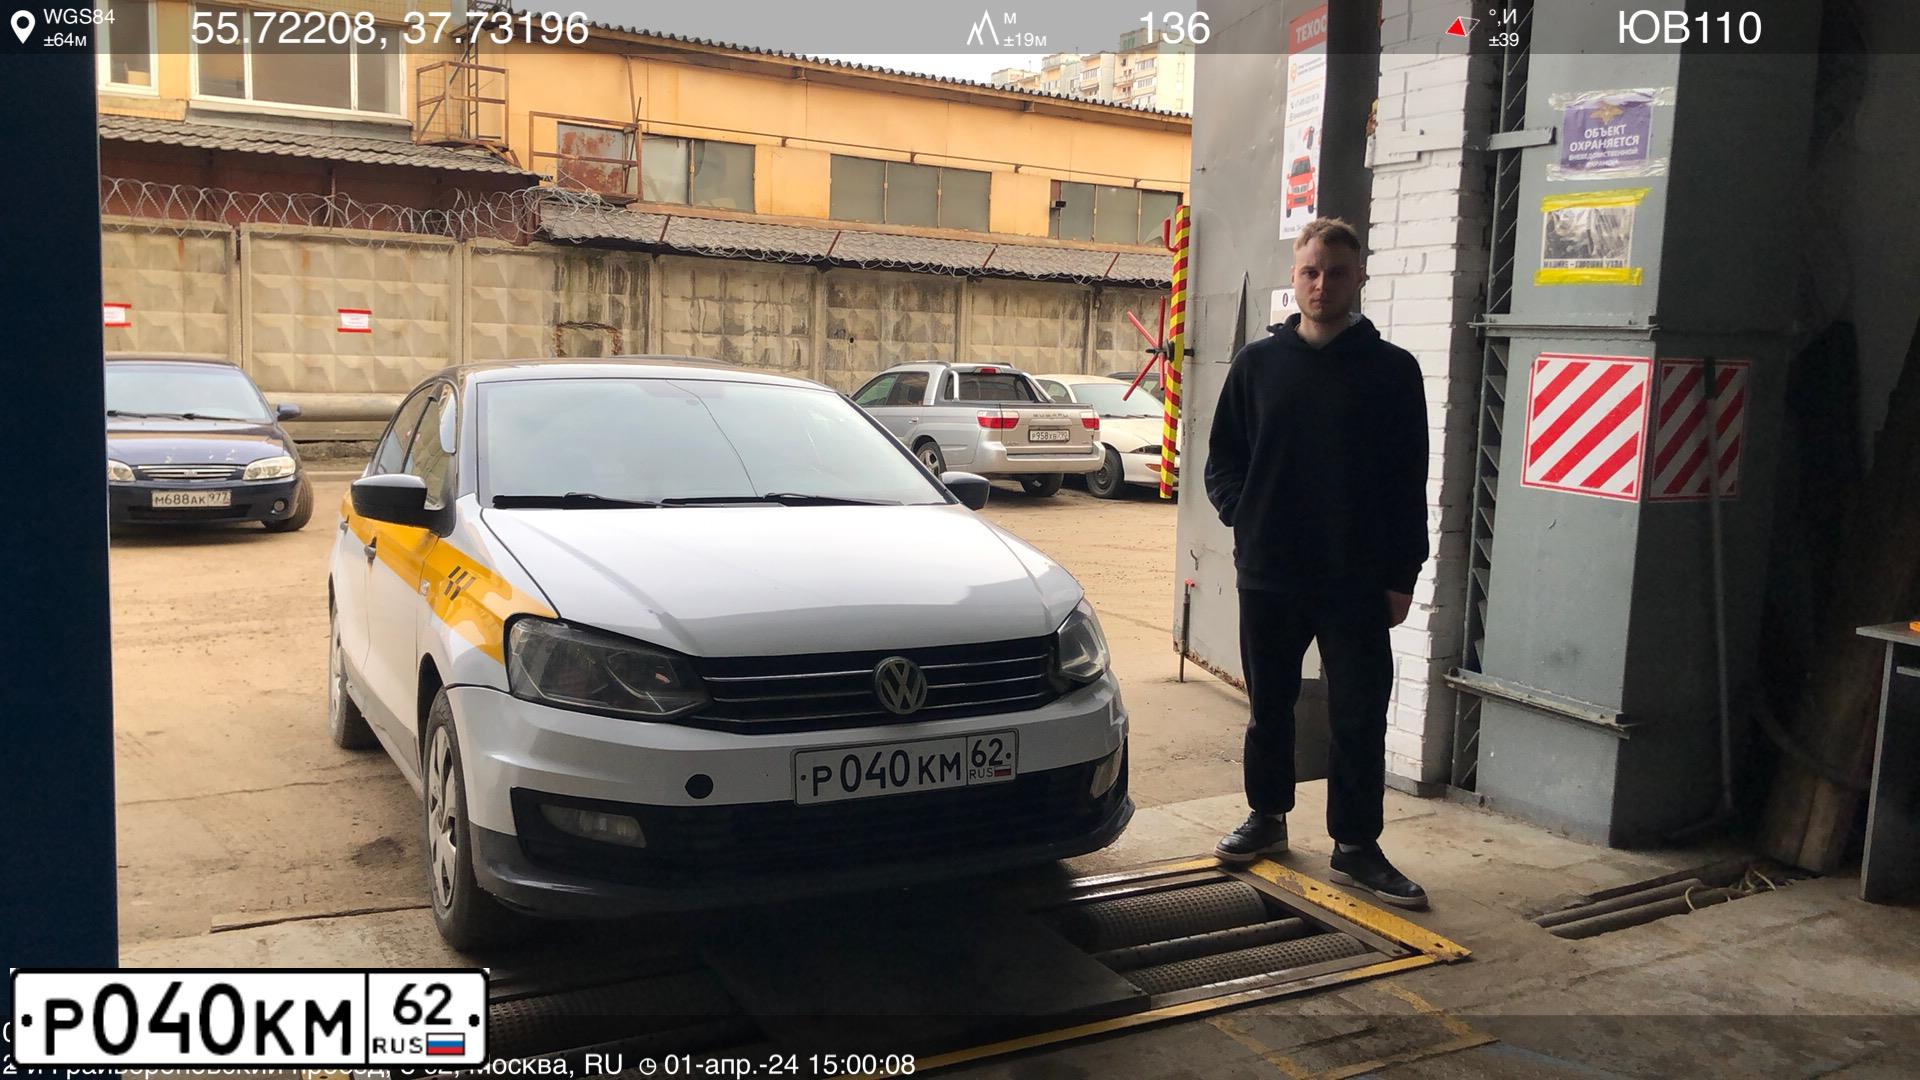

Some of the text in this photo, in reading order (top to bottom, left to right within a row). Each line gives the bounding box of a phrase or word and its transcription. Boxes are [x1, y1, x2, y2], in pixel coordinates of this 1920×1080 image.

[1583, 124, 1627, 139] ОБЪЕКТ
[1568, 135, 1640, 152] ОХРАНЯЕТСЯ
[970, 737, 1004, 768] 62
[969, 767, 994, 780] RUS
